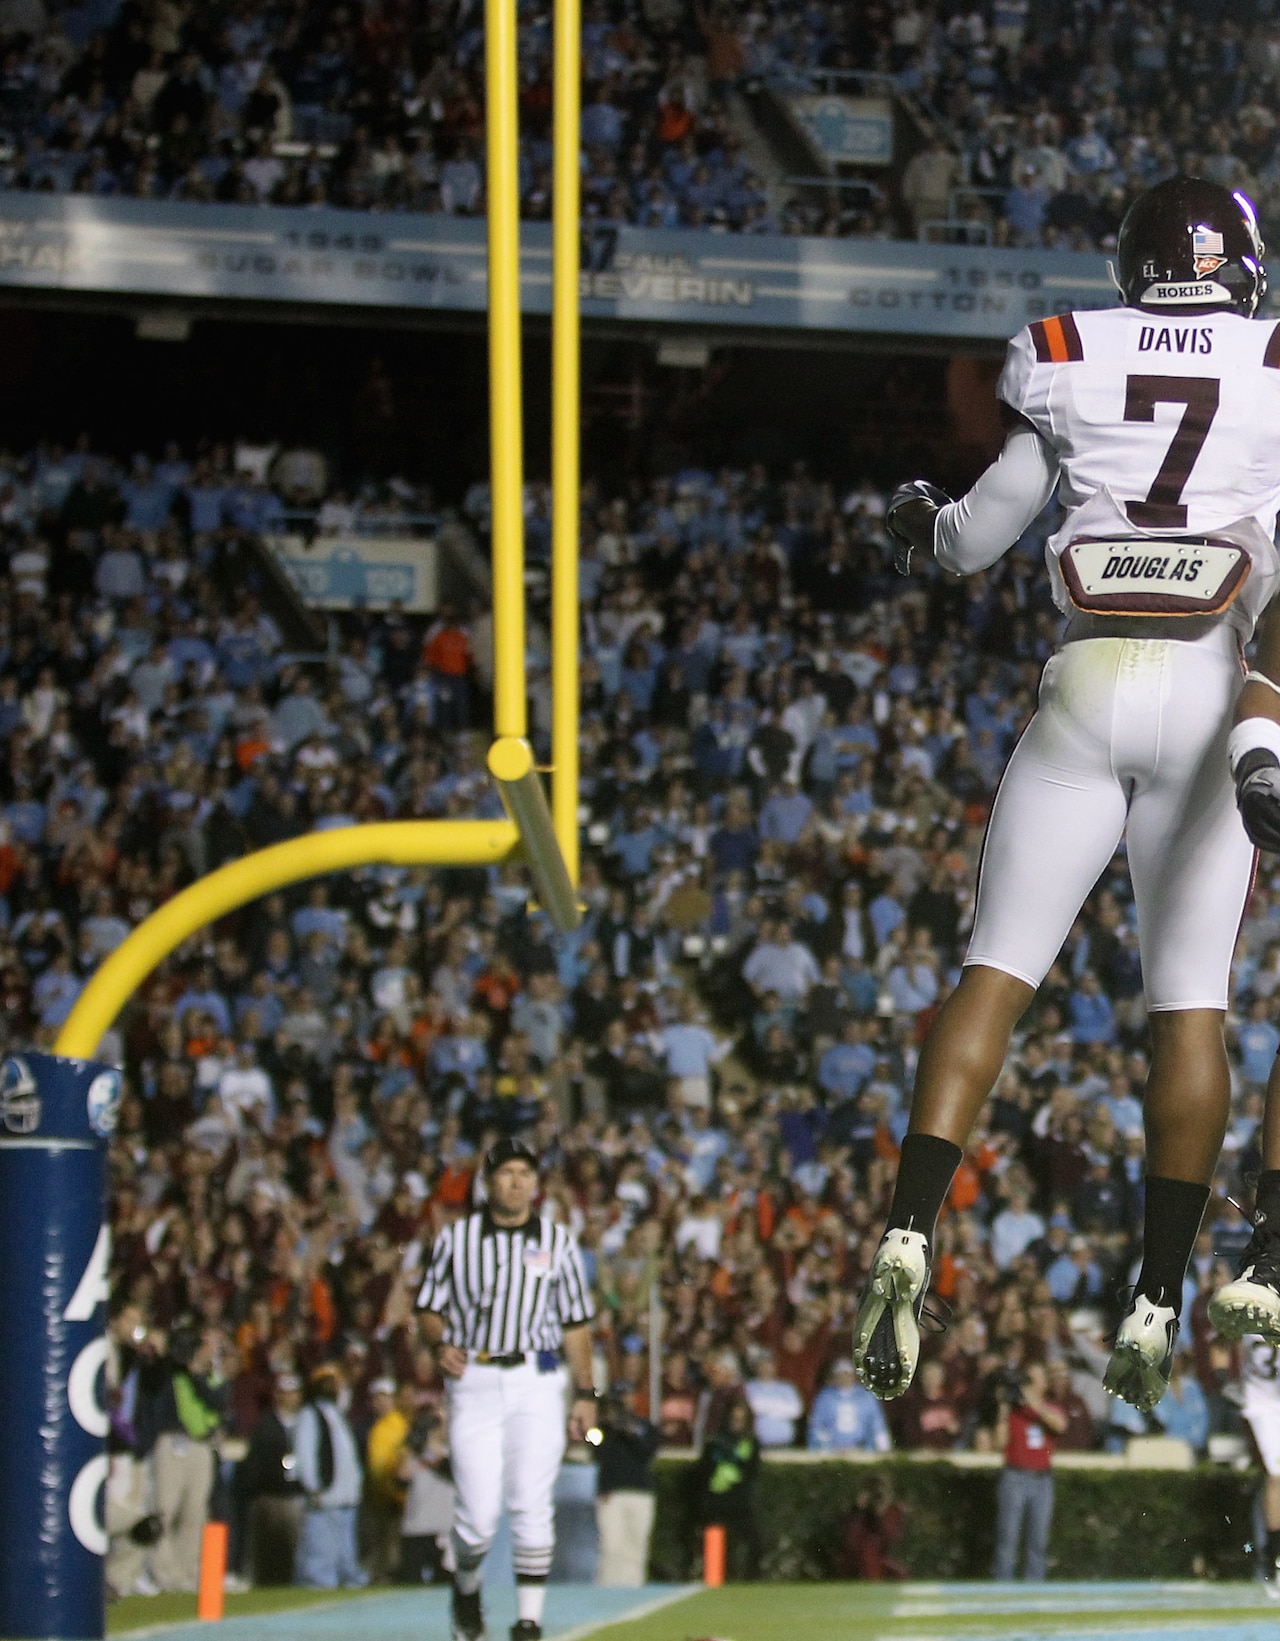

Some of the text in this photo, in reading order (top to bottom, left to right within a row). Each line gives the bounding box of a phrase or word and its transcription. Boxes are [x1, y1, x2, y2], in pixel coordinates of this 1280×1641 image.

[353, 260, 461, 286] BOWL
[1198, 261, 1217, 269] ACC
[850, 287, 1007, 313] COTTON
[1157, 285, 1213, 298] HOKIES
[1138, 326, 1213, 354] DAVIS
[1123, 374, 1221, 528] 7
[1101, 555, 1204, 582] DOUGLAS
